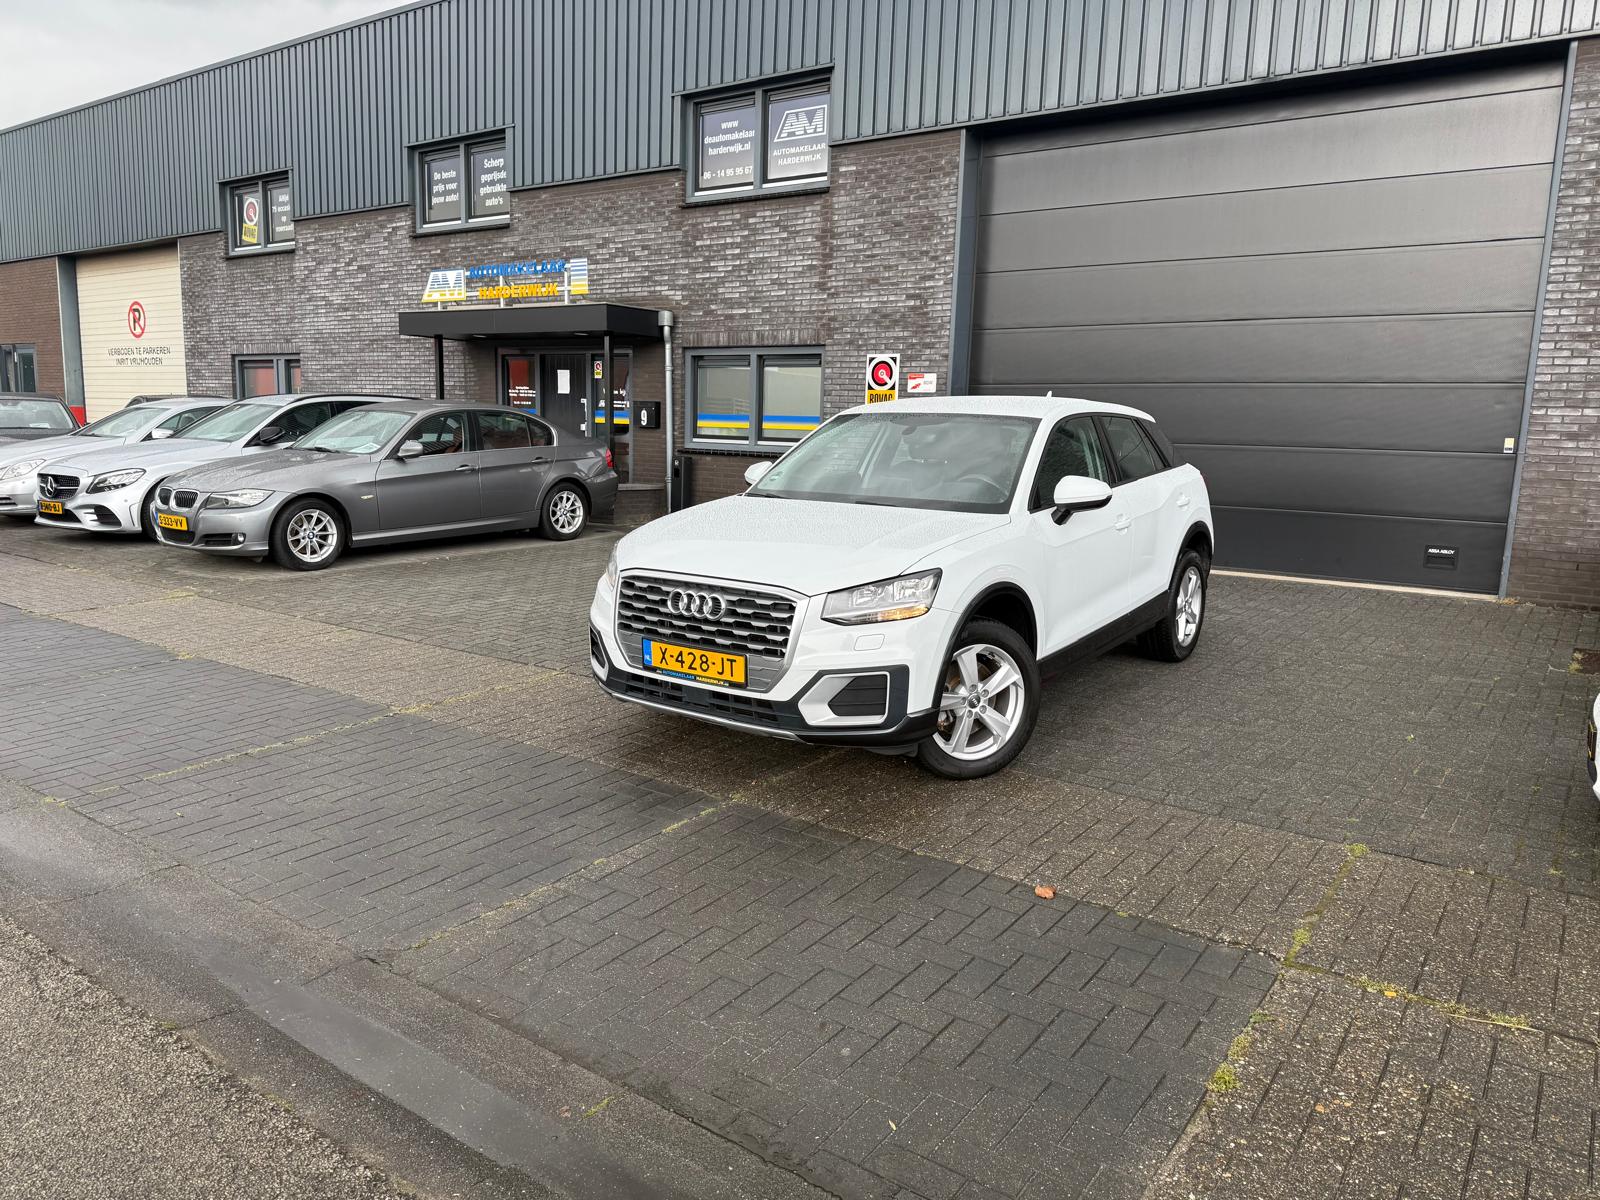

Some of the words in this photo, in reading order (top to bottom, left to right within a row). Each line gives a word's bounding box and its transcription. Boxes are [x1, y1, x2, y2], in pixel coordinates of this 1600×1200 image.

[721, 120, 739, 129] www
[704, 130, 755, 144] deautomakelaar
[708, 141, 751, 156] harderwijk.nl
[773, 143, 826, 156] AUTOMAKELAAR
[483, 158, 504, 168] Scherp
[777, 153, 822, 166] HARDERWIJK
[434, 172, 441, 180] De
[442, 170, 456, 178] beste
[703, 171, 712, 180] 06
[717, 169, 725, 177] 14
[726, 168, 734, 176] 95
[735, 167, 744, 175] 95
[745, 166, 753, 175] 67
[433, 184, 445, 193] prijs
[446, 182, 458, 190] voor
[480, 183, 506, 196] gebruikte
[431, 195, 444, 205] jouw
[485, 197, 503, 206] auto's
[468, 259, 567, 279] AUTOMAKELAAR
[478, 283, 559, 299] HARDERWIJK
[108, 347, 134, 356] VERBODEN
[135, 347, 141, 355] TE
[142, 346, 171, 355] PARKEREN
[640, 409, 648, 426] 9
[659, 646, 737, 678] X-428-JT
